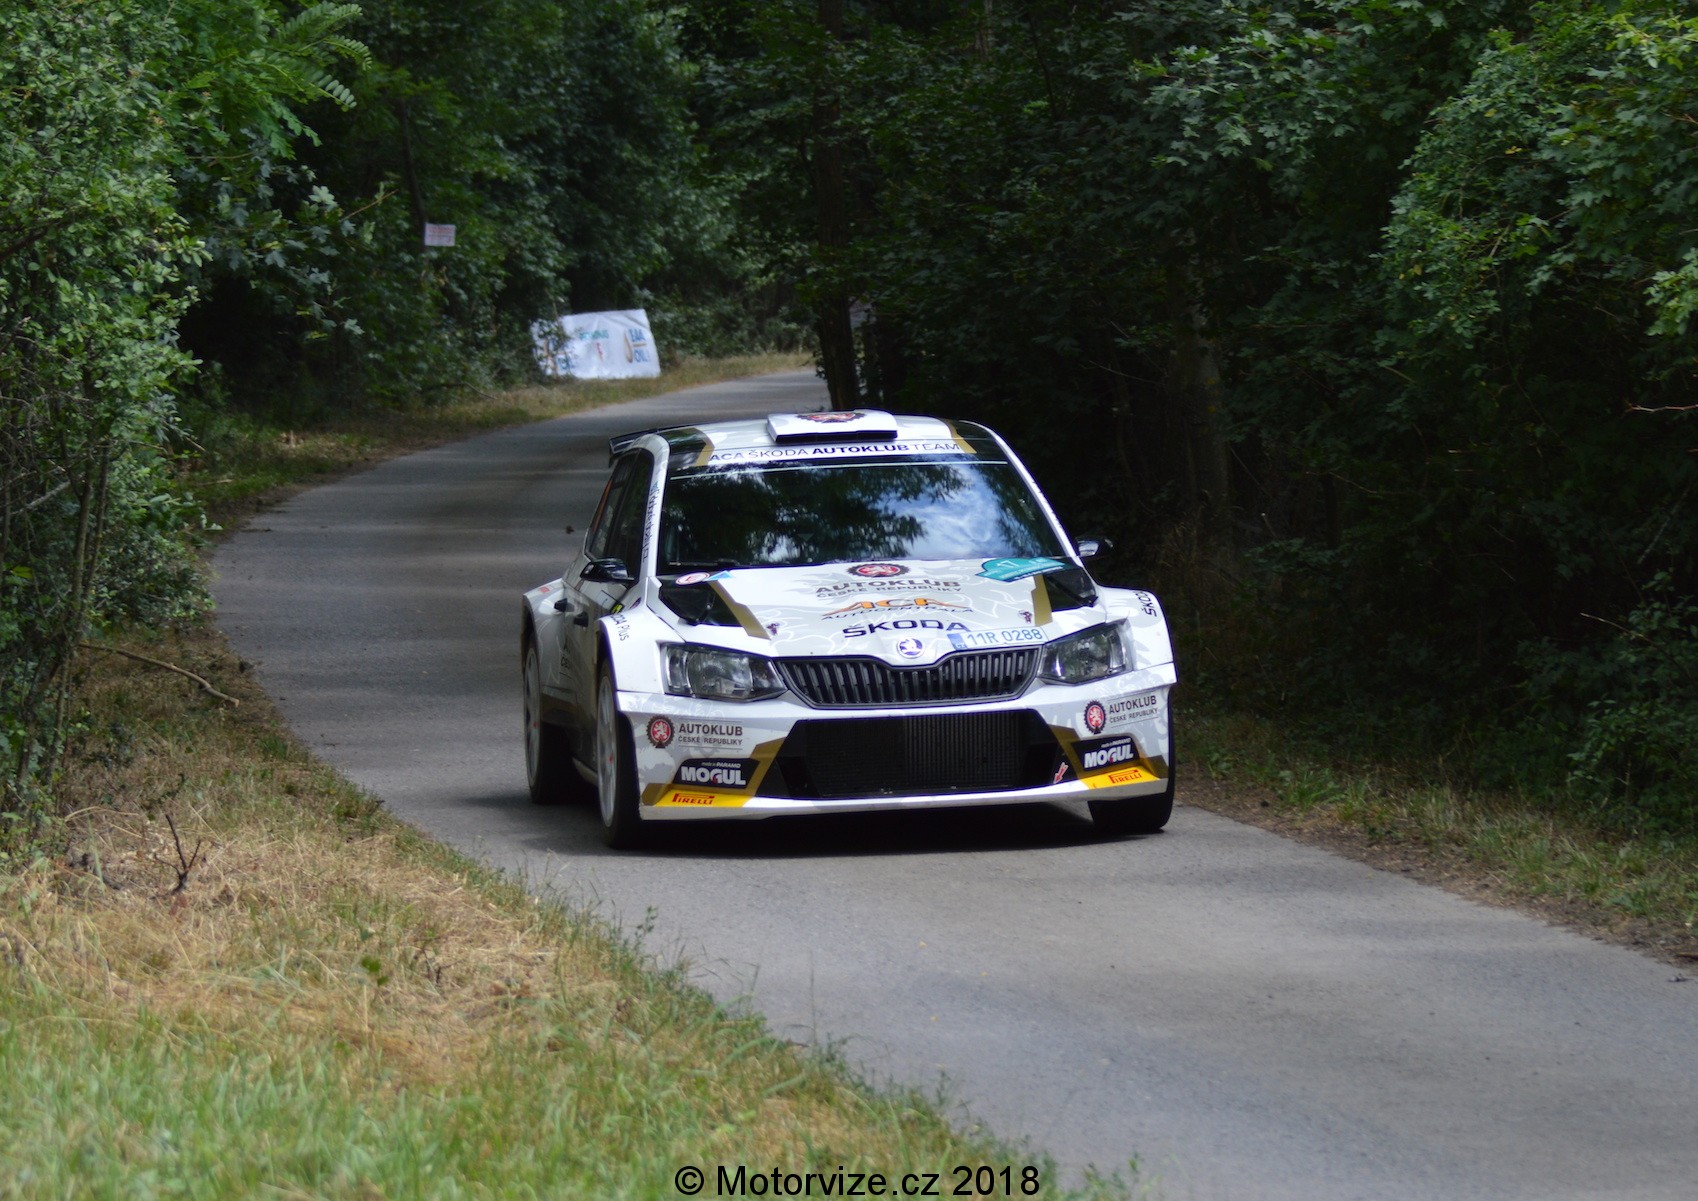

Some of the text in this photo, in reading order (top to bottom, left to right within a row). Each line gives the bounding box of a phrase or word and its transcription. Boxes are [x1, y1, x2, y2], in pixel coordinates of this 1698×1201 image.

[710, 452, 744, 461] ACA
[748, 448, 809, 459] ŠKODA
[812, 445, 909, 455] AUTOKLUB
[815, 579, 961, 593] AUTOKLUB
[821, 606, 974, 621] AUTOCENTRALA
[842, 619, 971, 639] ŠKODA
[967, 631, 1000, 646] 11R
[1001, 628, 1043, 643] 0288
[1108, 695, 1157, 715] AUTOKLUB
[1109, 707, 1158, 724] ČESKÉ REPUBLIKY
[679, 723, 743, 737] AUTOKLUB
[678, 736, 743, 746] ČESKÉ REPUBLIKY
[1084, 744, 1134, 769] MOGUL
[681, 766, 747, 786] MOGUL
[1108, 769, 1143, 784] PIRELLI
[672, 793, 716, 805] PIRELLI
